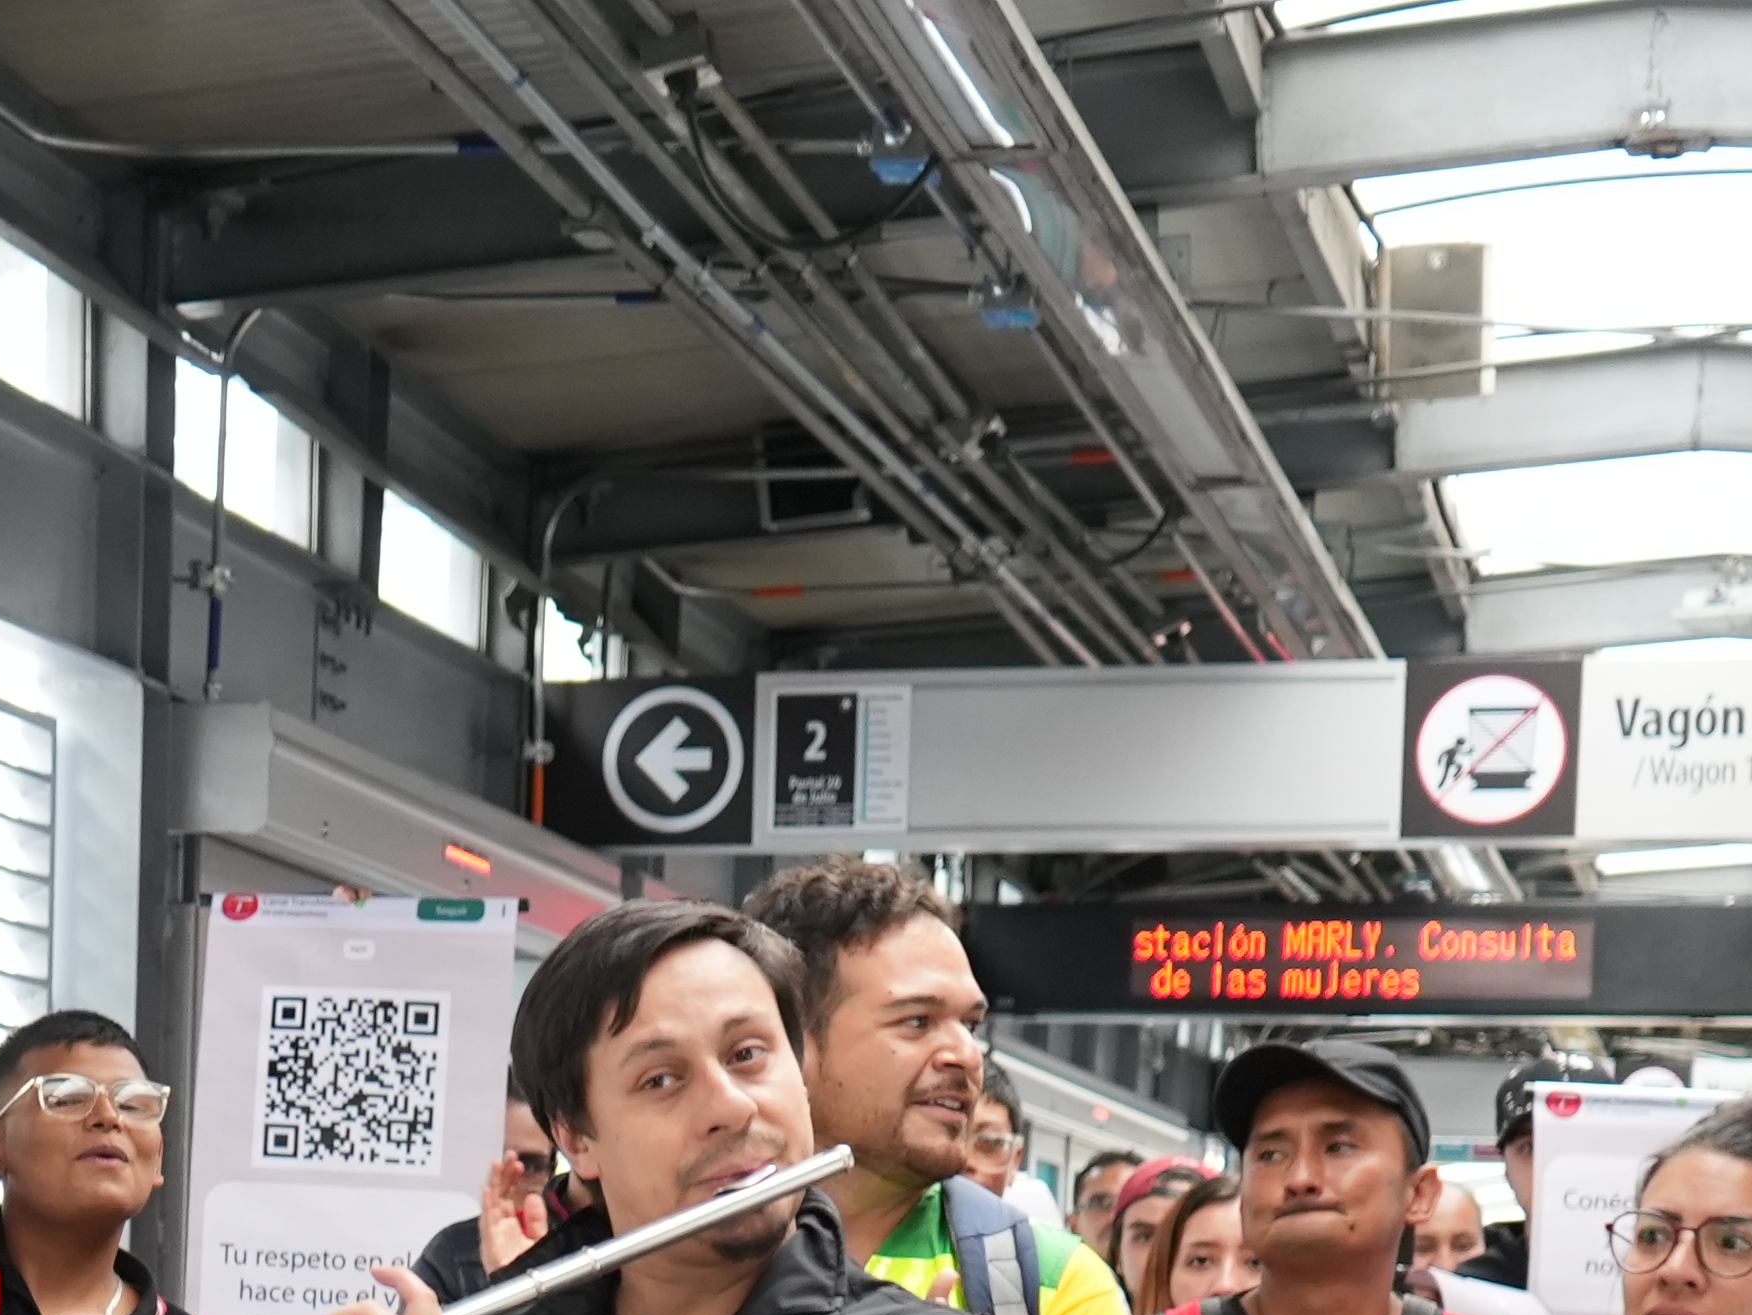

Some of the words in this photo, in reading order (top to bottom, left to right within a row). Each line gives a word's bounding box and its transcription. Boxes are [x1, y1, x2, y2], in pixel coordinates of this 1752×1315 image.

[802, 718, 828, 763] 2
[1615, 694, 1746, 749] Vagón
[1132, 922, 1267, 961] stación
[1281, 920, 1397, 961] MARLY.
[1418, 919, 1578, 961] Consulta
[1150, 961, 1192, 999] de
[1210, 962, 1267, 999] las
[1280, 960, 1422, 999] mujeres
[219, 1243, 247, 1266] Tu
[255, 1247, 347, 1273] respeto
[353, 1254, 382, 1272] en
[239, 1279, 295, 1303] hace
[302, 1287, 349, 1308] que
